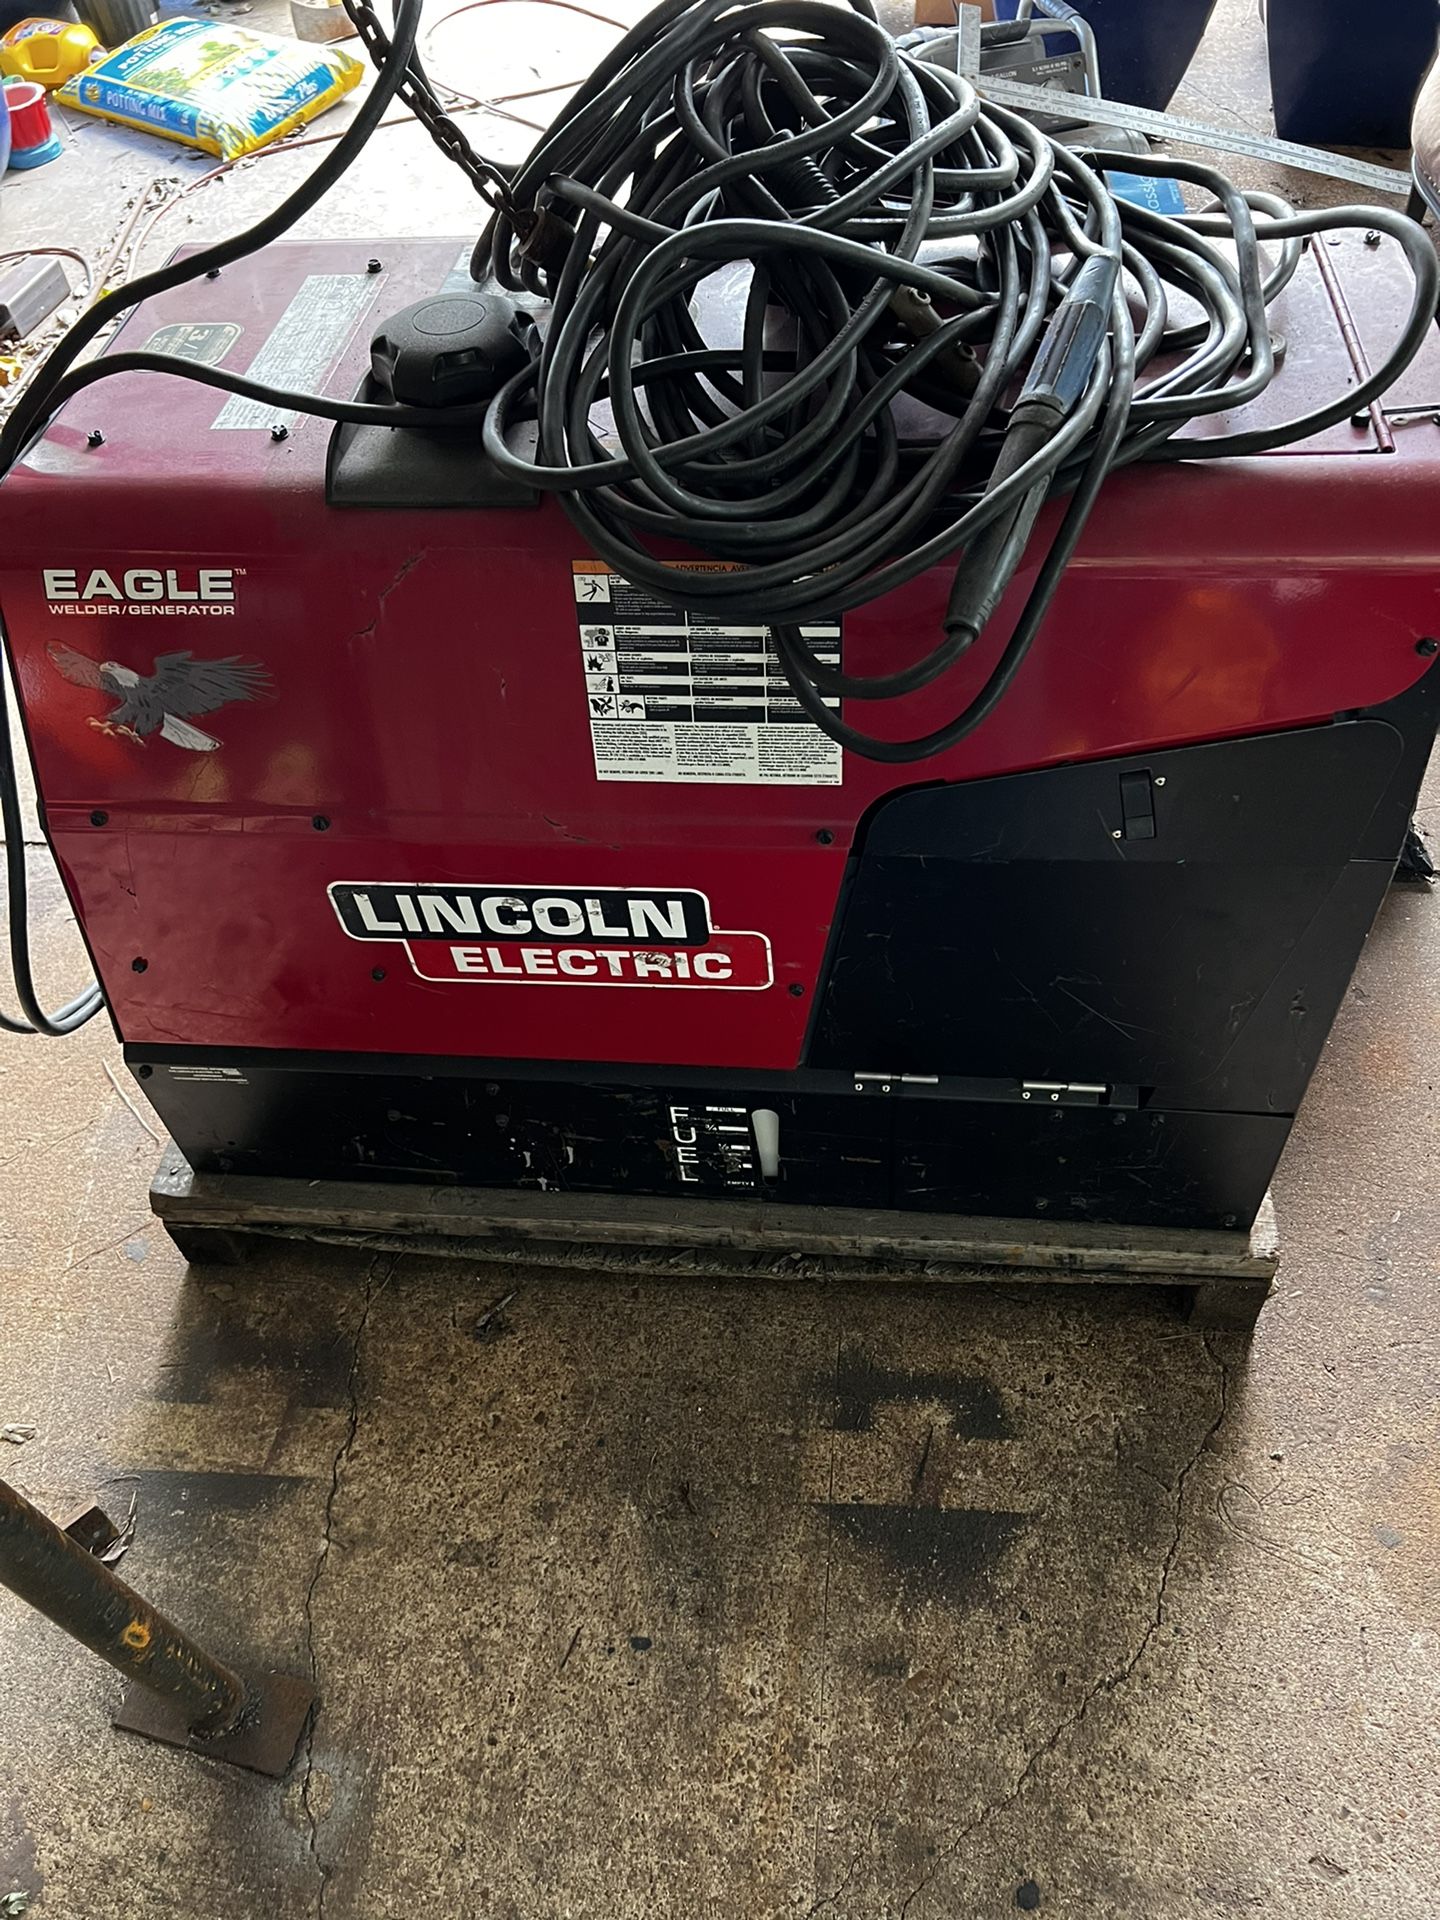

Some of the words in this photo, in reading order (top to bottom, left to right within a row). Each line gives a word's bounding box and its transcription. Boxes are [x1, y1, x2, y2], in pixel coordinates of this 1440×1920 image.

[106, 90, 147, 116] POTTING
[147, 103, 167, 121] MIX
[43, 569, 235, 600] EAGLE
[49, 605, 235, 616] WELDER/GENERATOR
[352, 893, 688, 939] LINCOLN
[450, 946, 734, 979] ELECTRIC
[670, 1106, 699, 1182] FUEL
